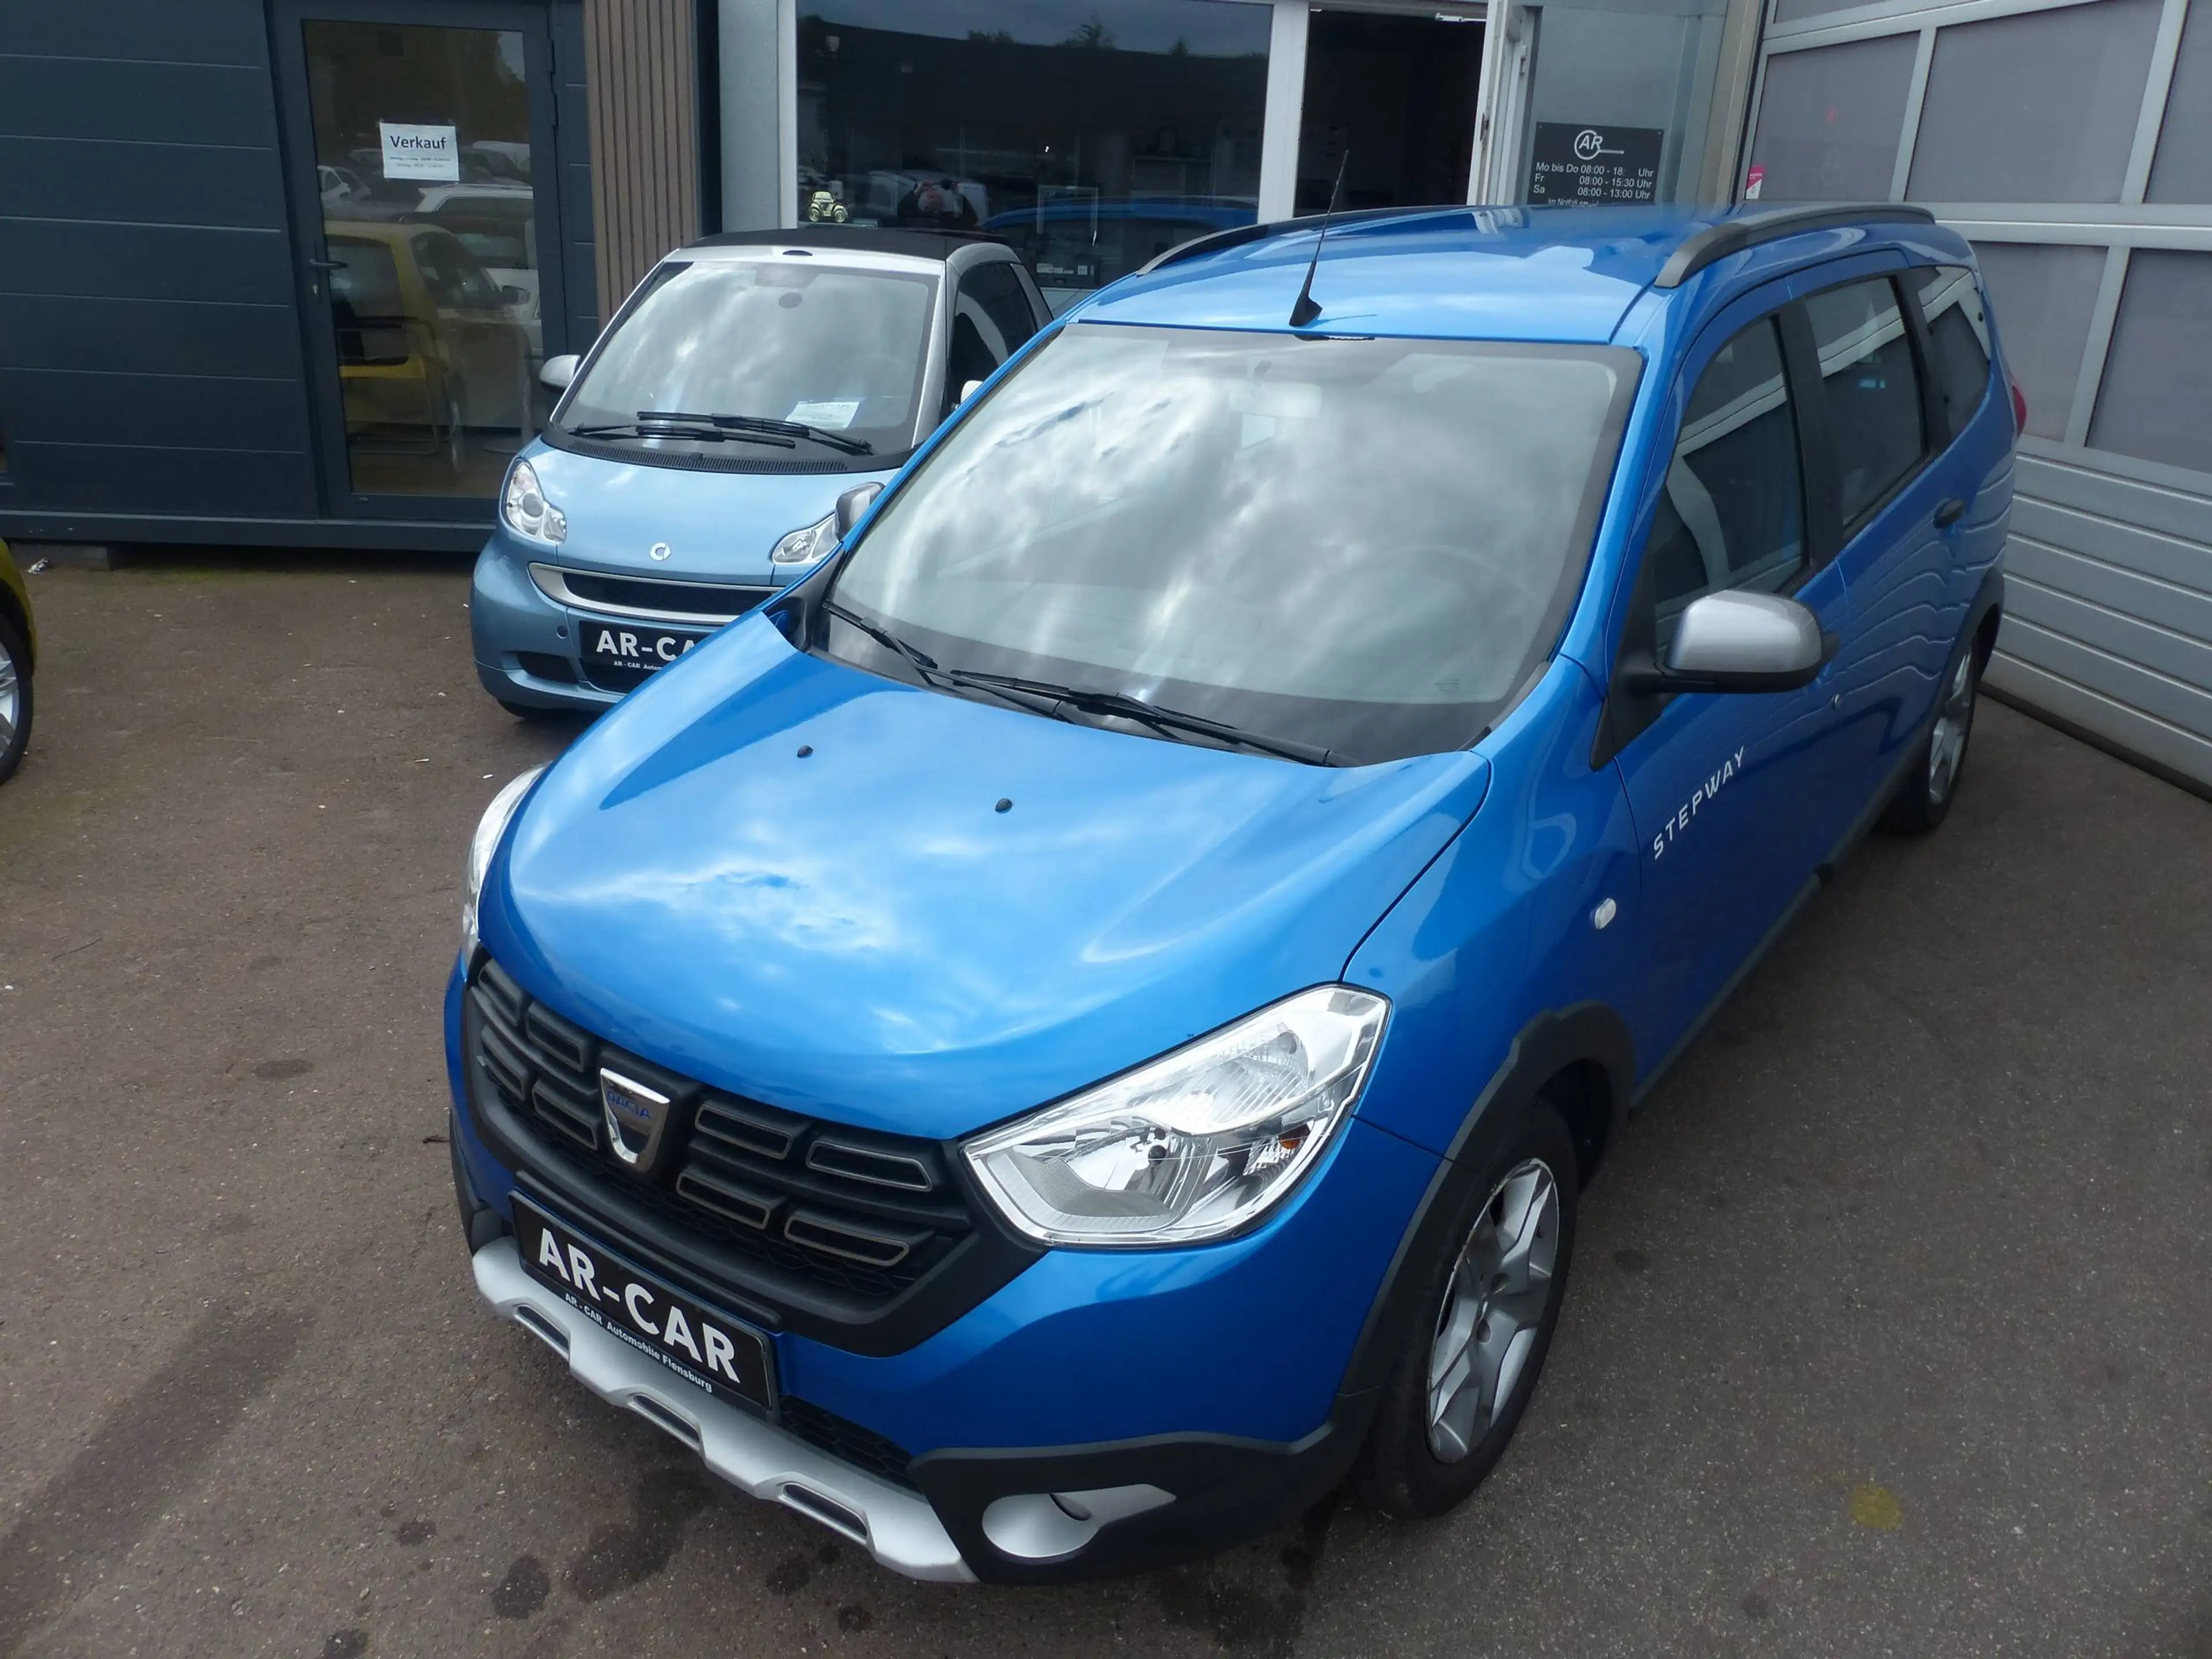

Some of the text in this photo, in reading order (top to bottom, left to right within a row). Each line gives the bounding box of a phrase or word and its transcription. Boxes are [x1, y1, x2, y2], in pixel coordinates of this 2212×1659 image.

[390, 135, 446, 149] Verkauf
[1578, 135, 1603, 150] AR
[1536, 162, 1550, 172] Mo
[1552, 163, 1564, 172] bis
[1567, 164, 1579, 173] Do
[1581, 165, 1605, 175] 08:00
[1638, 168, 1654, 177] Uhr
[1535, 173, 1545, 182] Fr
[1580, 176, 1603, 185] 08:00
[1612, 177, 1635, 187] 15:30
[1637, 179, 1653, 188] Uhr
[1533, 184, 1546, 194] Sa
[1578, 187, 1601, 196] 08:00
[1610, 189, 1633, 198] 13:00
[1635, 190, 1651, 199] Uhr
[1654, 745, 1744, 860] STEPWAY
[539, 1228, 740, 1383] AR-CAR
[607, 1321, 661, 1361] Automobile
[662, 1354, 713, 1393] Flensburg
